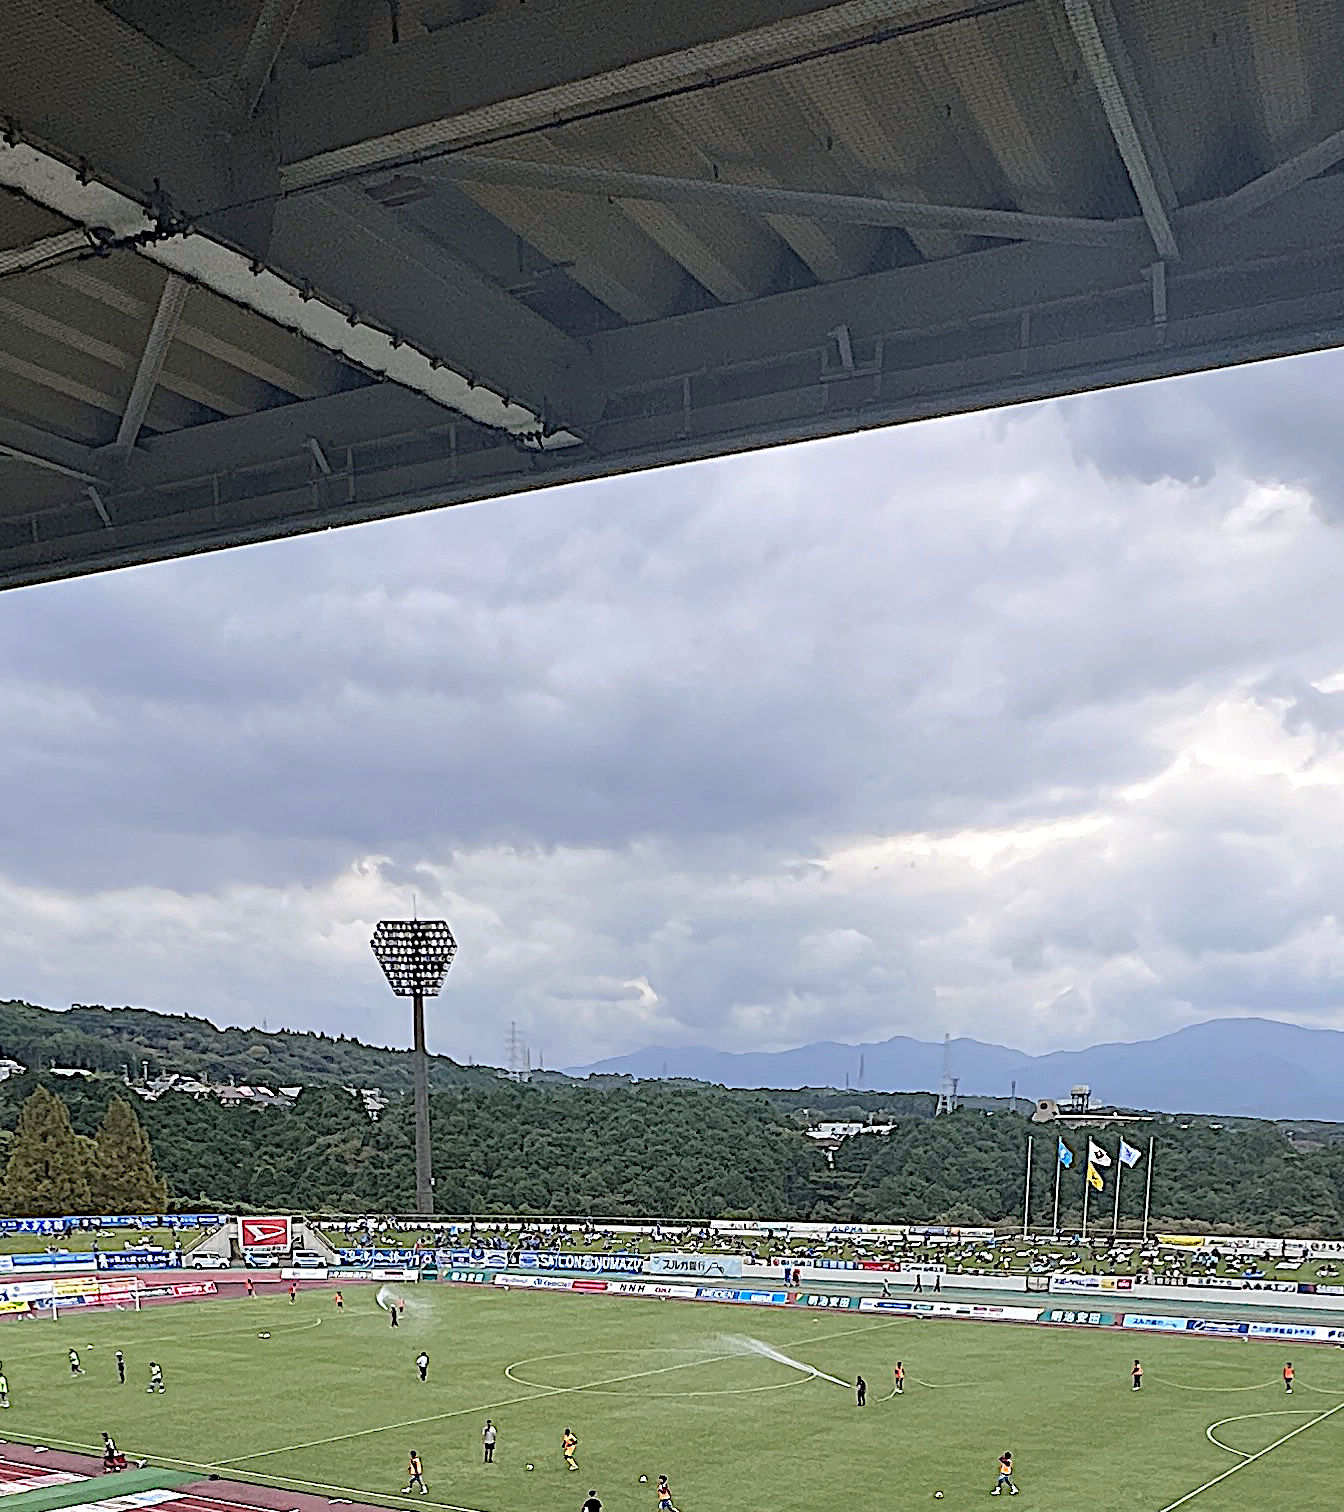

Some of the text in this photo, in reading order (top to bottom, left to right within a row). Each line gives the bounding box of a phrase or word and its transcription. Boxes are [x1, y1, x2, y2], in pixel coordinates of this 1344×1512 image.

[662, 1259, 705, 1271] スルガ銀行
[807, 1294, 851, 1309] 明治安田
[1050, 1310, 1101, 1324] 明治安田
